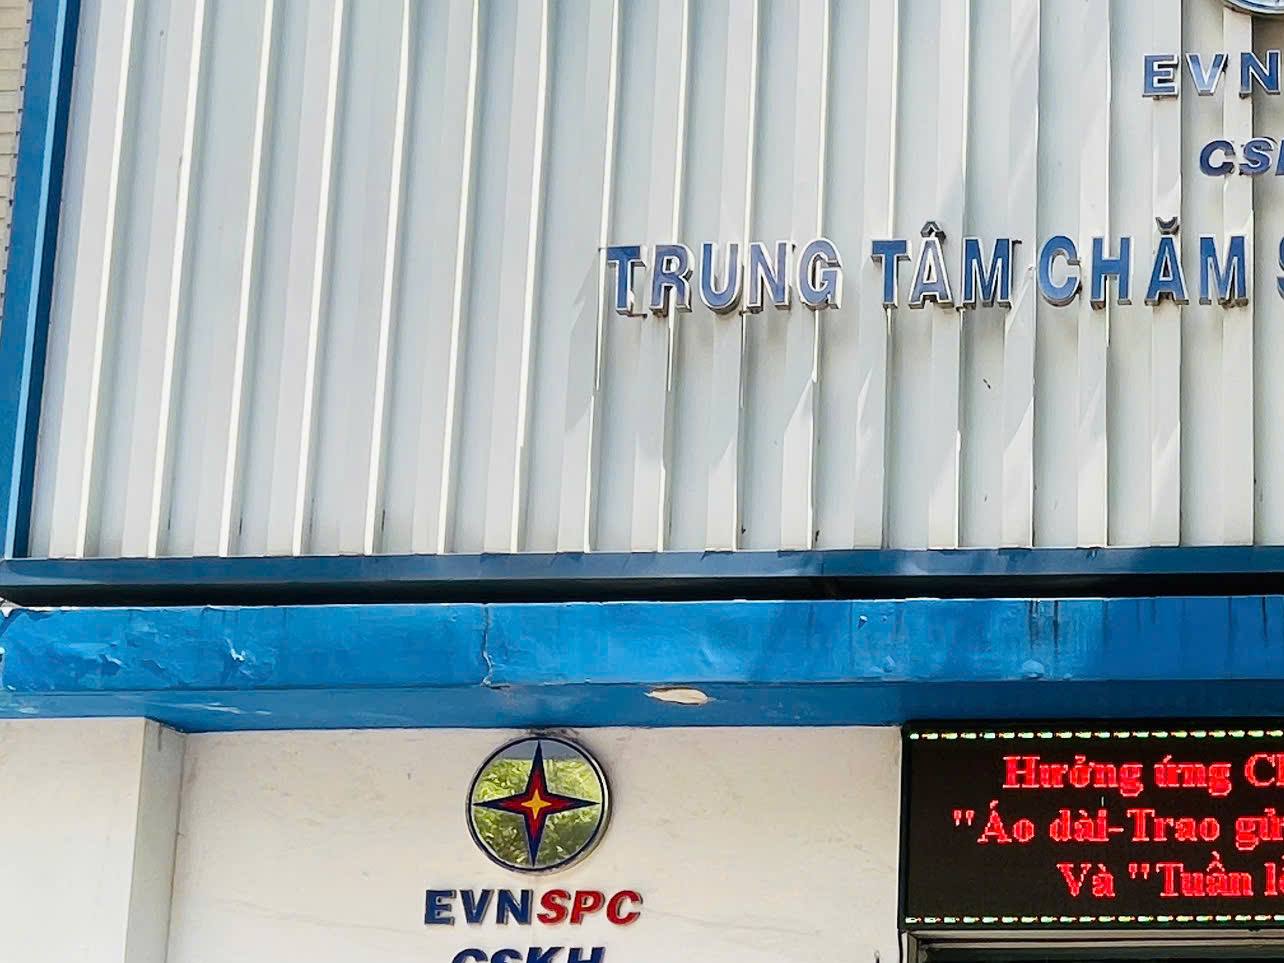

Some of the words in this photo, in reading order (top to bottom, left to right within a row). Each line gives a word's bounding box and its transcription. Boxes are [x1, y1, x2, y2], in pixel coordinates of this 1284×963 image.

[606, 240, 845, 315] TRUNG
[872, 221, 1020, 310] TÂM
[1038, 216, 1248, 307] CHĂM
[1003, 755, 1144, 797] Hưởng
[1154, 755, 1232, 797] ứng
[953, 800, 1035, 843] "Áo
[1056, 863, 1116, 897] Và
[1128, 851, 1253, 897] "Tuần
[423, 889, 643, 926] EVNSPC
